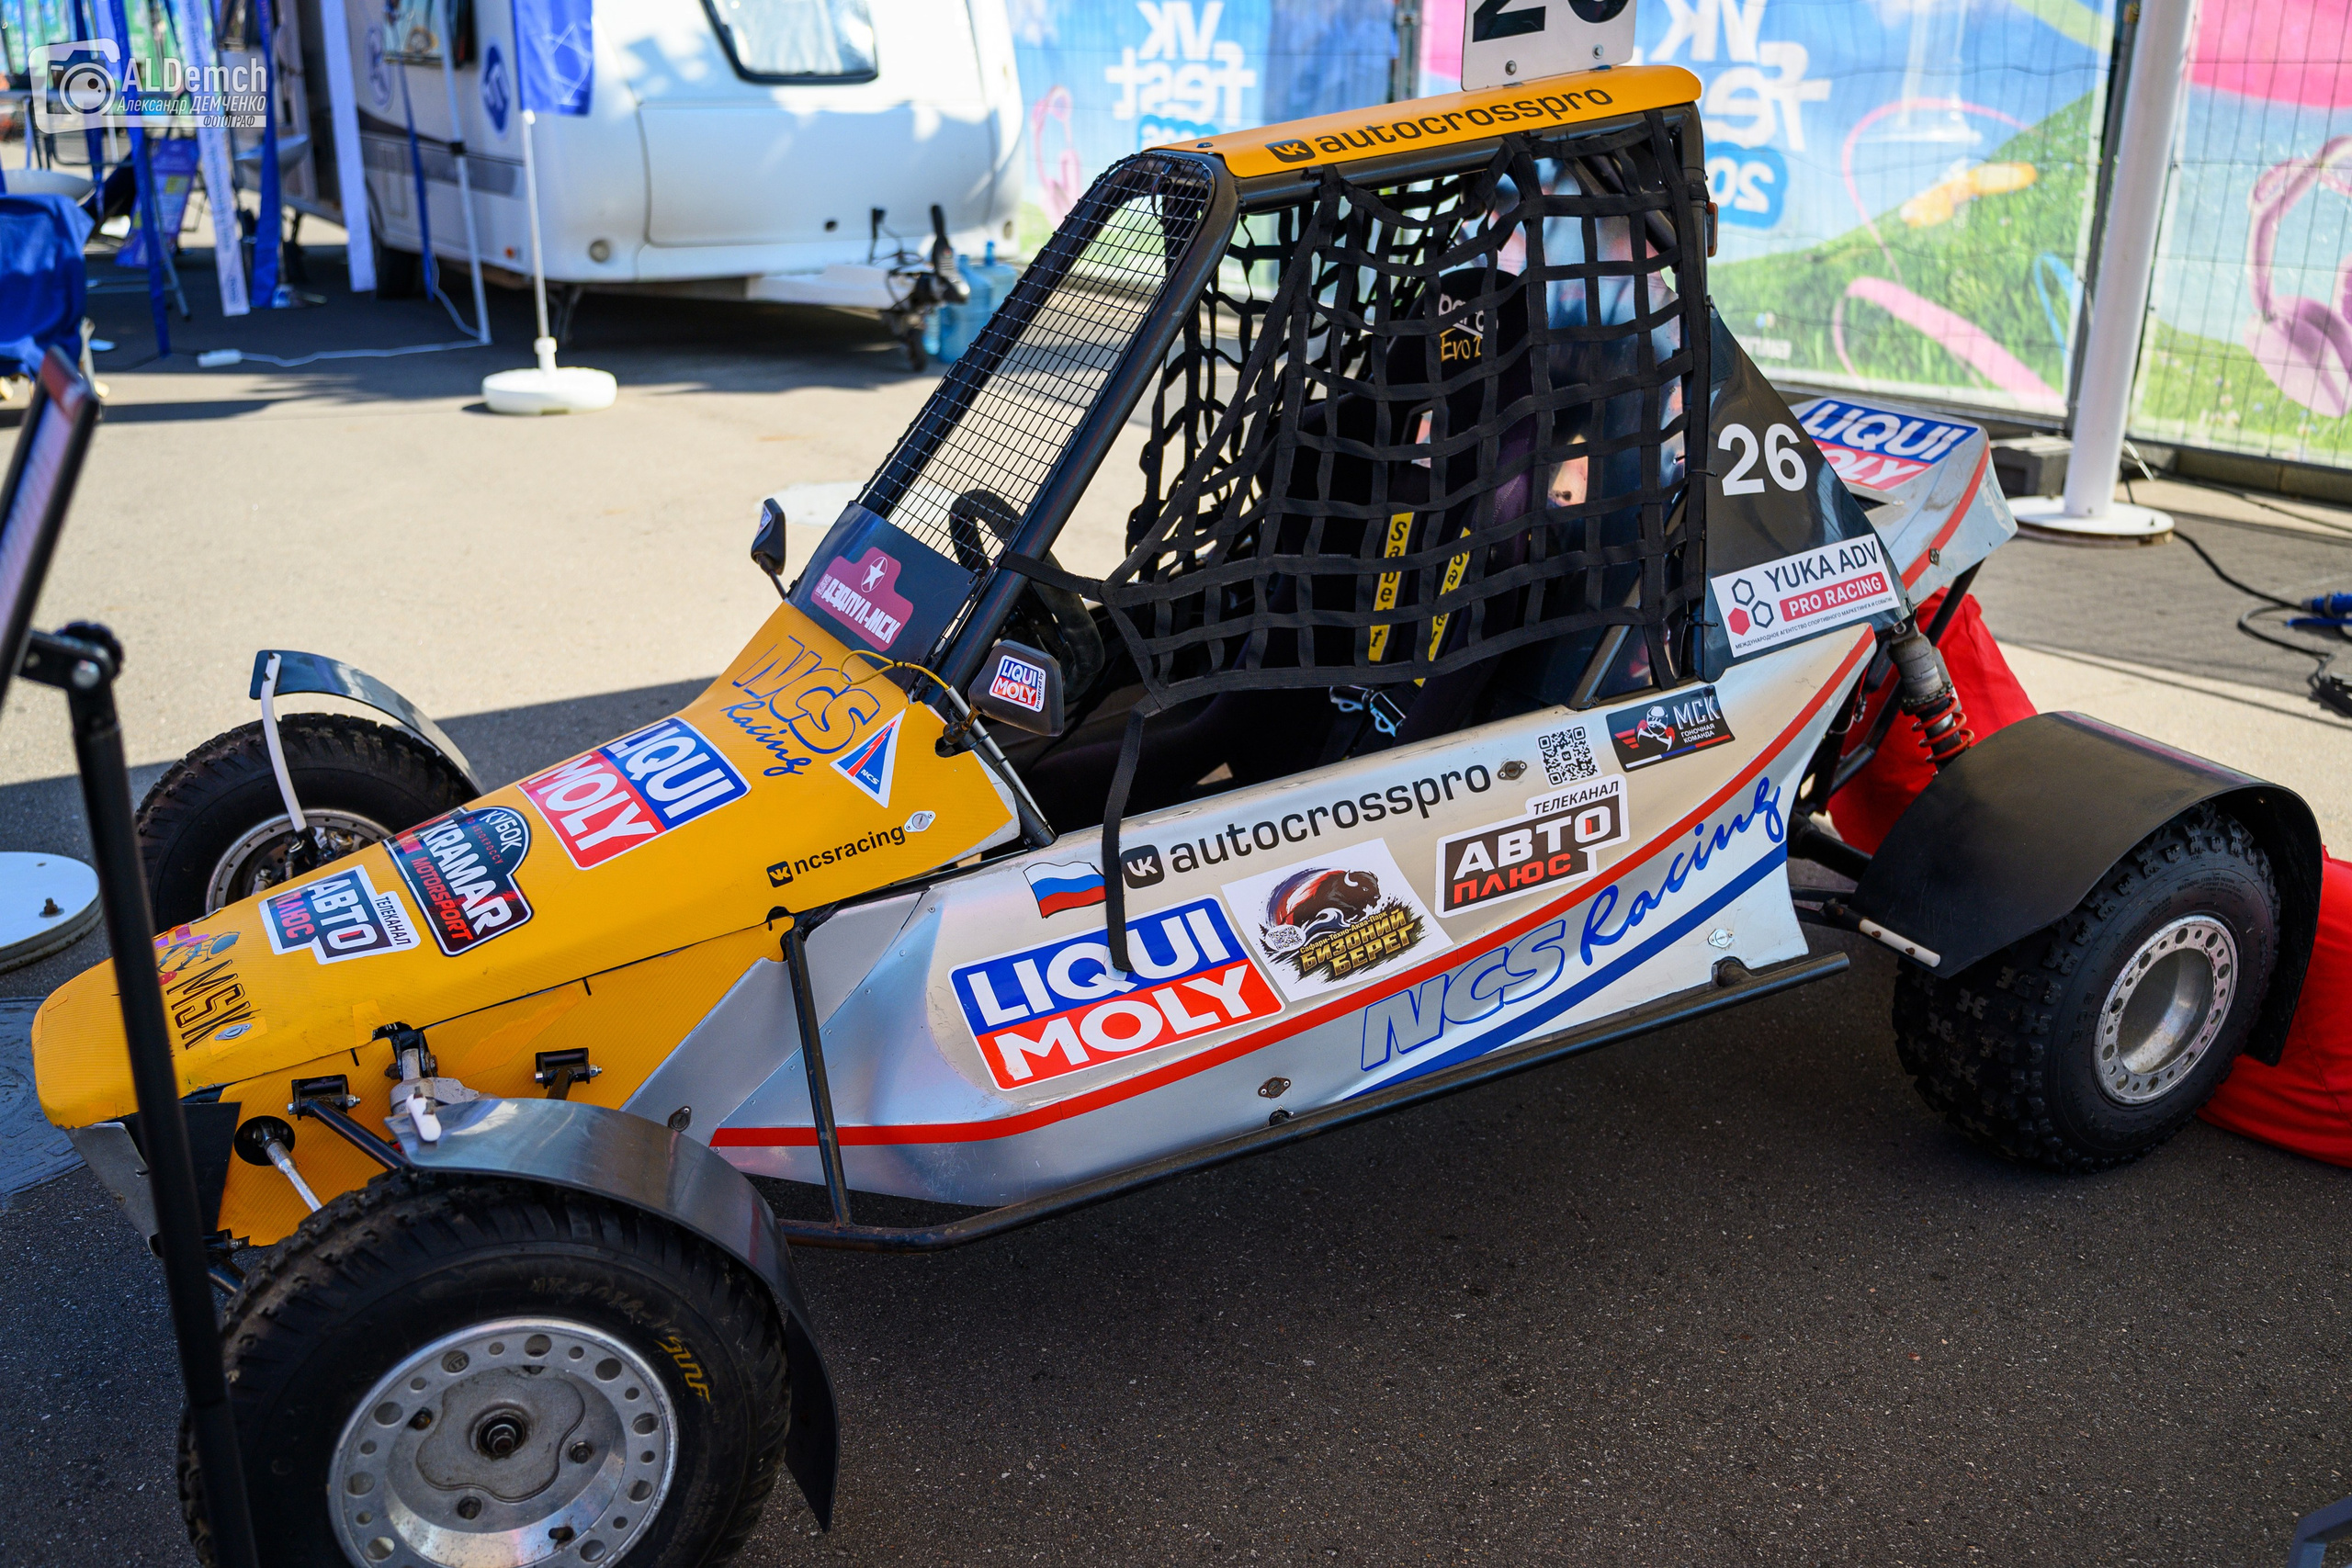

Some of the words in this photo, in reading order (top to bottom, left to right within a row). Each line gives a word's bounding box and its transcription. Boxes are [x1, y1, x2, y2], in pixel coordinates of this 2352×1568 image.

[1315, 88, 1613, 153] autocrosspro
[1718, 423, 1807, 496] 26
[1805, 403, 1967, 460] LIQUI
[1819, 446, 1926, 486] OLY
[1371, 521, 1408, 648] Sabet
[1764, 555, 1836, 592] YUKA
[1838, 541, 1878, 573] ADV
[1788, 593, 1822, 616] PRO
[1825, 576, 1882, 606] RACING
[1736, 632, 1781, 649] МЕЖДУНАРОДНОЕ
[1780, 622, 1807, 637] АГЕНТСТВО
[1808, 612, 1842, 626] СПОРТИВНОГО
[1841, 603, 1871, 617] МАРКЕТИНГА
[732, 635, 881, 754] NCS
[993, 677, 1036, 705] MOLY
[1001, 660, 1037, 687] LIQUI
[719, 701, 812, 777] Racing
[1672, 695, 1721, 730] МСК
[1680, 723, 1715, 739] ГОНОЧНАЯ
[1683, 730, 1715, 744] КОМАНДА
[605, 722, 735, 819] LIQUI
[860, 768, 880, 785] NCS
[1533, 781, 1618, 816] ТЕЛЕКАНАЛ
[527, 754, 658, 852] MOLY
[1170, 764, 1492, 874] autocrosspro
[480, 810, 523, 853] КУБОК
[794, 824, 907, 875] ncsracing
[1453, 806, 1611, 881] АВТО
[411, 856, 474, 942] MOTORSPORT
[420, 819, 512, 936] KRAMAR
[1453, 853, 1571, 904] ПЛЮС
[276, 891, 316, 939] ПЛЮС
[307, 878, 378, 950] АВТО
[375, 896, 413, 946] ТЕЛЕКАНАЛ
[1299, 908, 1407, 972] БИЗОНИЙ
[1361, 919, 1566, 1072] NCS
[1580, 776, 1784, 966] Racing
[967, 908, 1231, 1027] LIQUI
[1329, 921, 1416, 976] БЕРЕГ
[993, 964, 1252, 1081] MOLY
